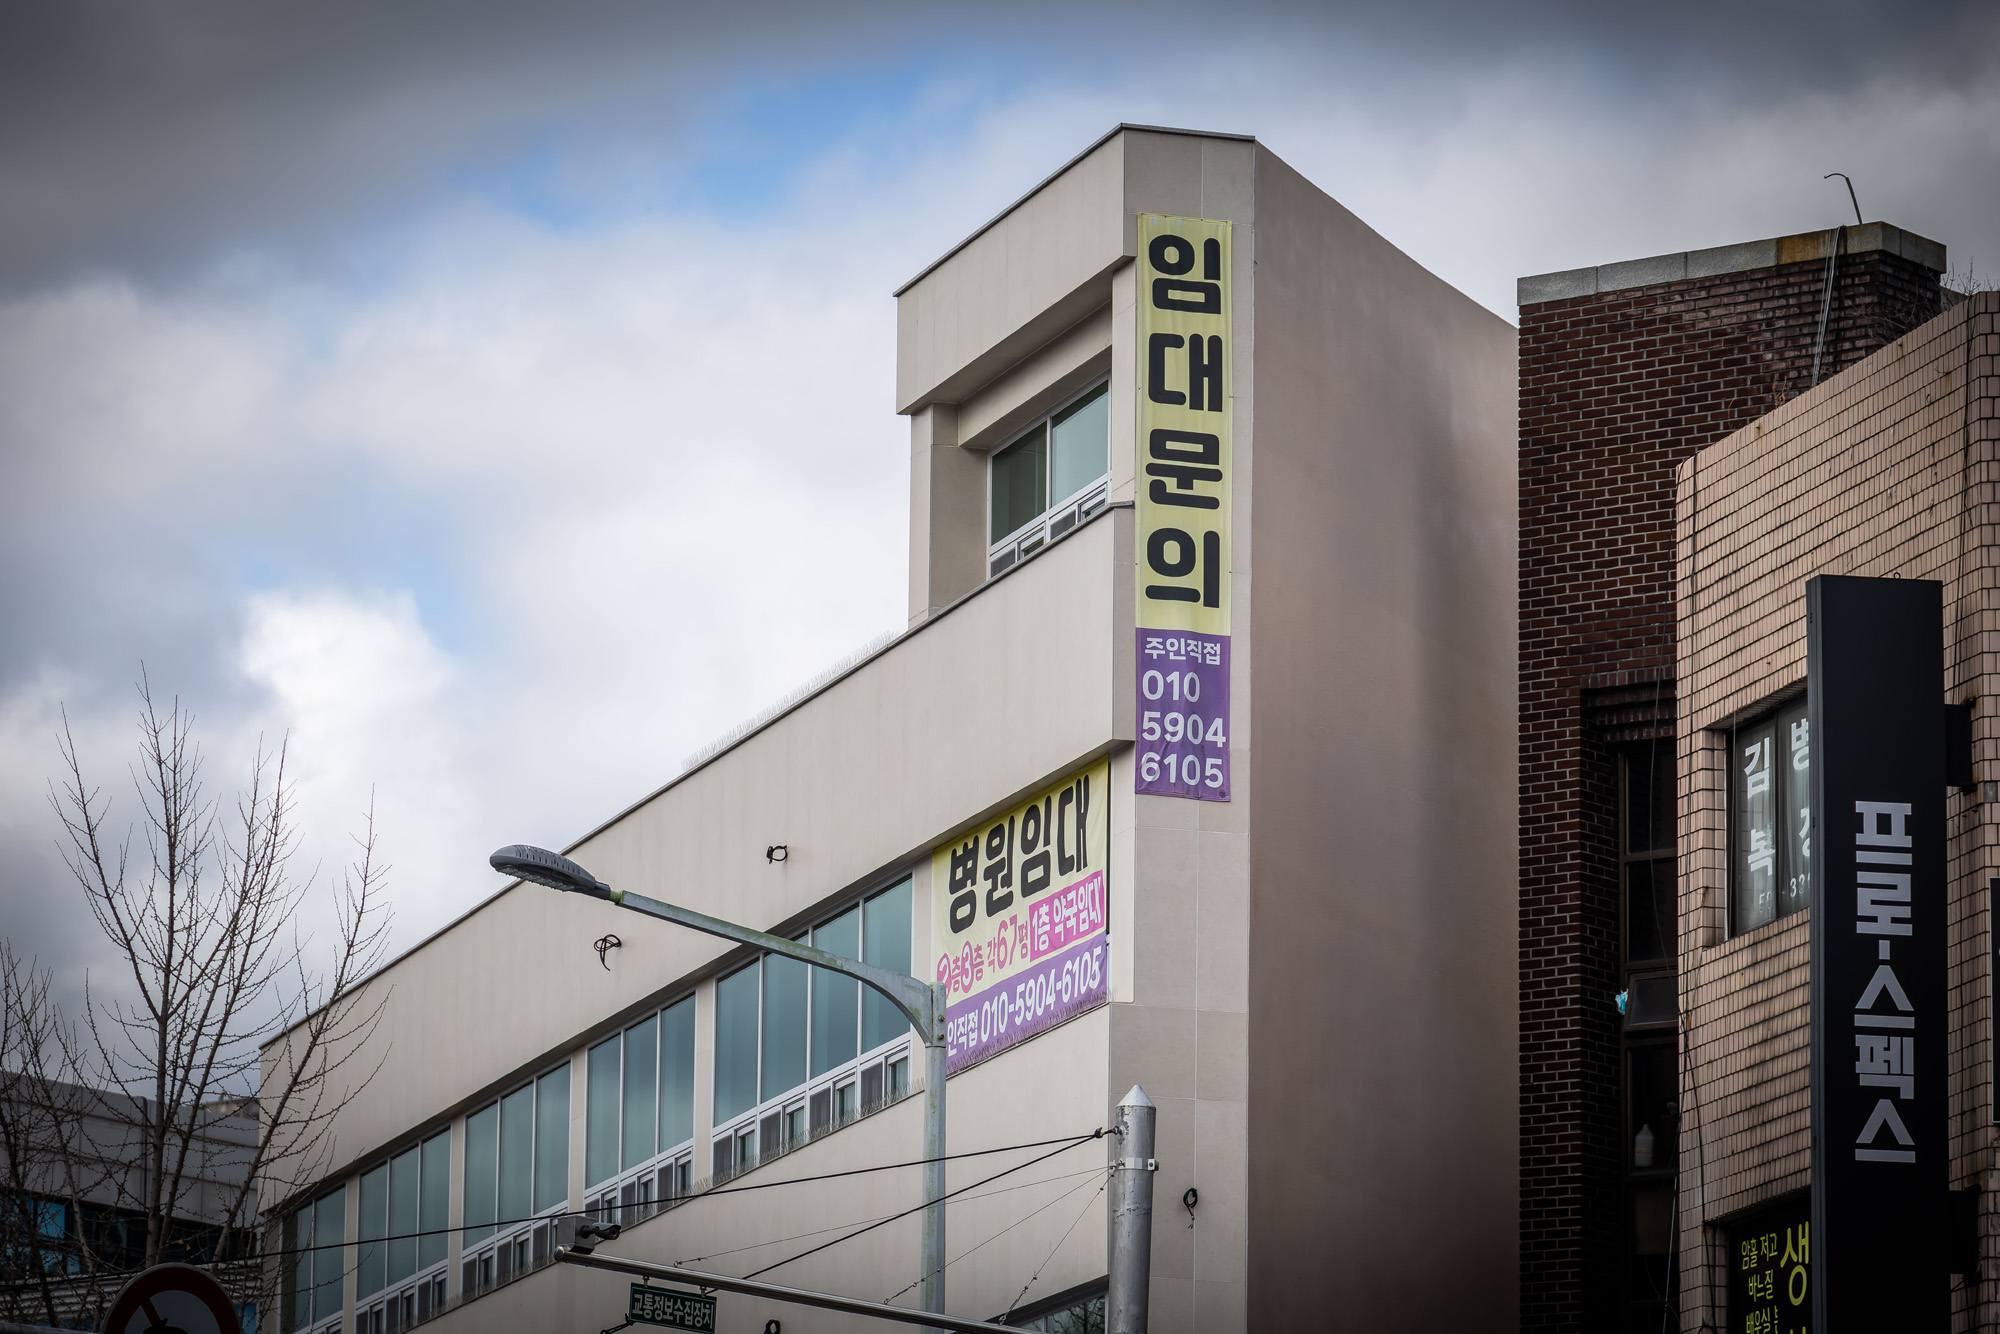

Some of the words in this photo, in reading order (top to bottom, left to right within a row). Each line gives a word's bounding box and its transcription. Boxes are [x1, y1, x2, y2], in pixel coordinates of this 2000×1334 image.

[1145, 233, 1224, 610] 임대문의
[1144, 637, 1221, 666] 주인직접
[1142, 669, 1201, 703] 010
[1141, 710, 1227, 748] 5904
[1140, 751, 1224, 789] 6105
[948, 774, 1090, 935] 병원임대
[1032, 903, 1051, 953] 1층
[1053, 874, 1103, 944] 약국임대
[945, 1009, 979, 1057] 인직접
[980, 945, 1102, 1043] 010-5904-6105
[1748, 1269, 1774, 1302] 바느질
[632, 1293, 714, 1330] 교통정보수집장치
